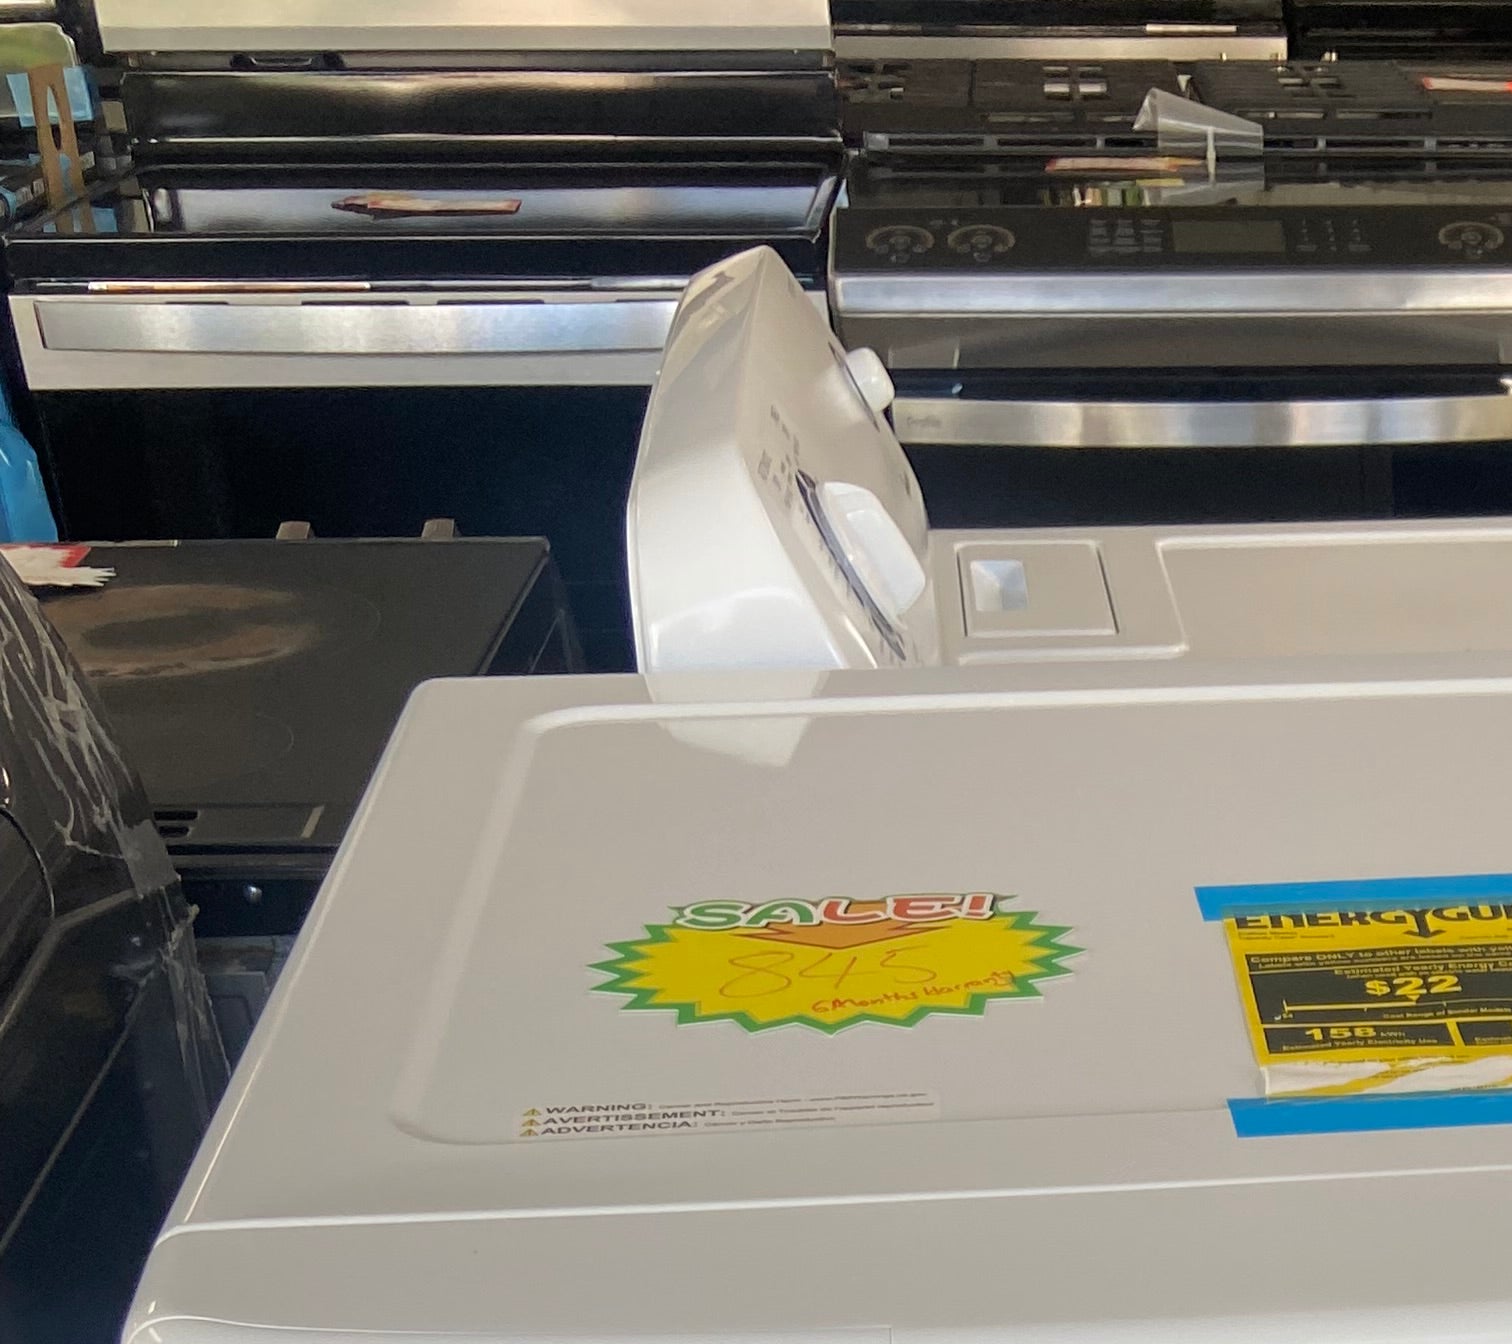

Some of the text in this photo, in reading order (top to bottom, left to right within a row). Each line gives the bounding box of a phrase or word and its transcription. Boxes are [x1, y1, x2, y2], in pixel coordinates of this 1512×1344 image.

[675, 893, 994, 929] SALE!
[719, 946, 937, 998] 845
[1365, 975, 1462, 997] $22
[1304, 1027, 1376, 1041] 158
[546, 1102, 651, 1114] WARNING:
[543, 1109, 725, 1125] AVERTISSEMENT:
[540, 1121, 698, 1136] ADVERTENCIA:
